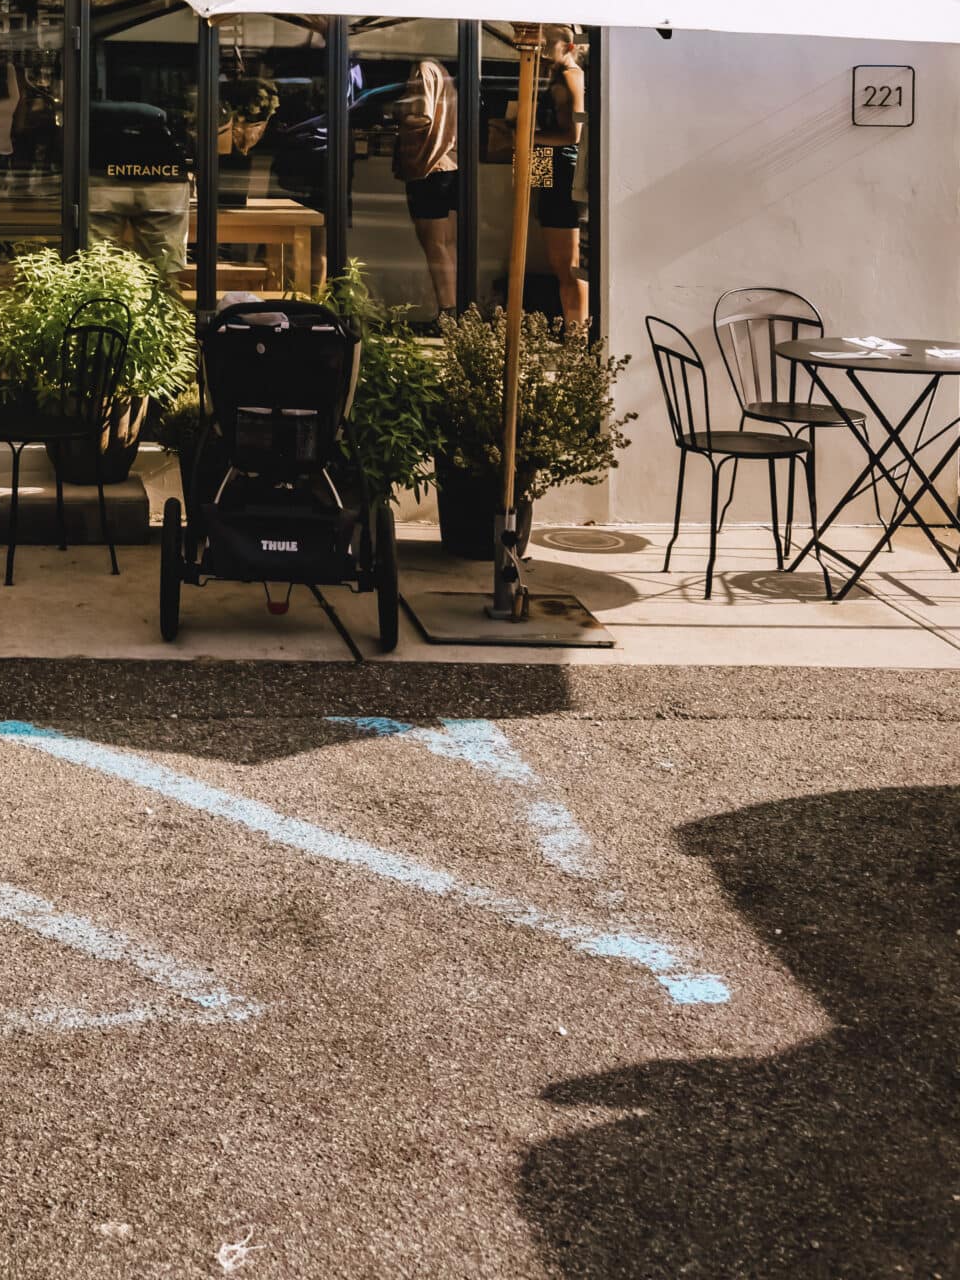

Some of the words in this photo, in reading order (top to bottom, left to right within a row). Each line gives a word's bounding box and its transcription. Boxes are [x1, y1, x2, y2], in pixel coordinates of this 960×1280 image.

[862, 85, 903, 108] 221
[107, 164, 179, 176] ENTRANCE
[261, 540, 298, 551] THULE
